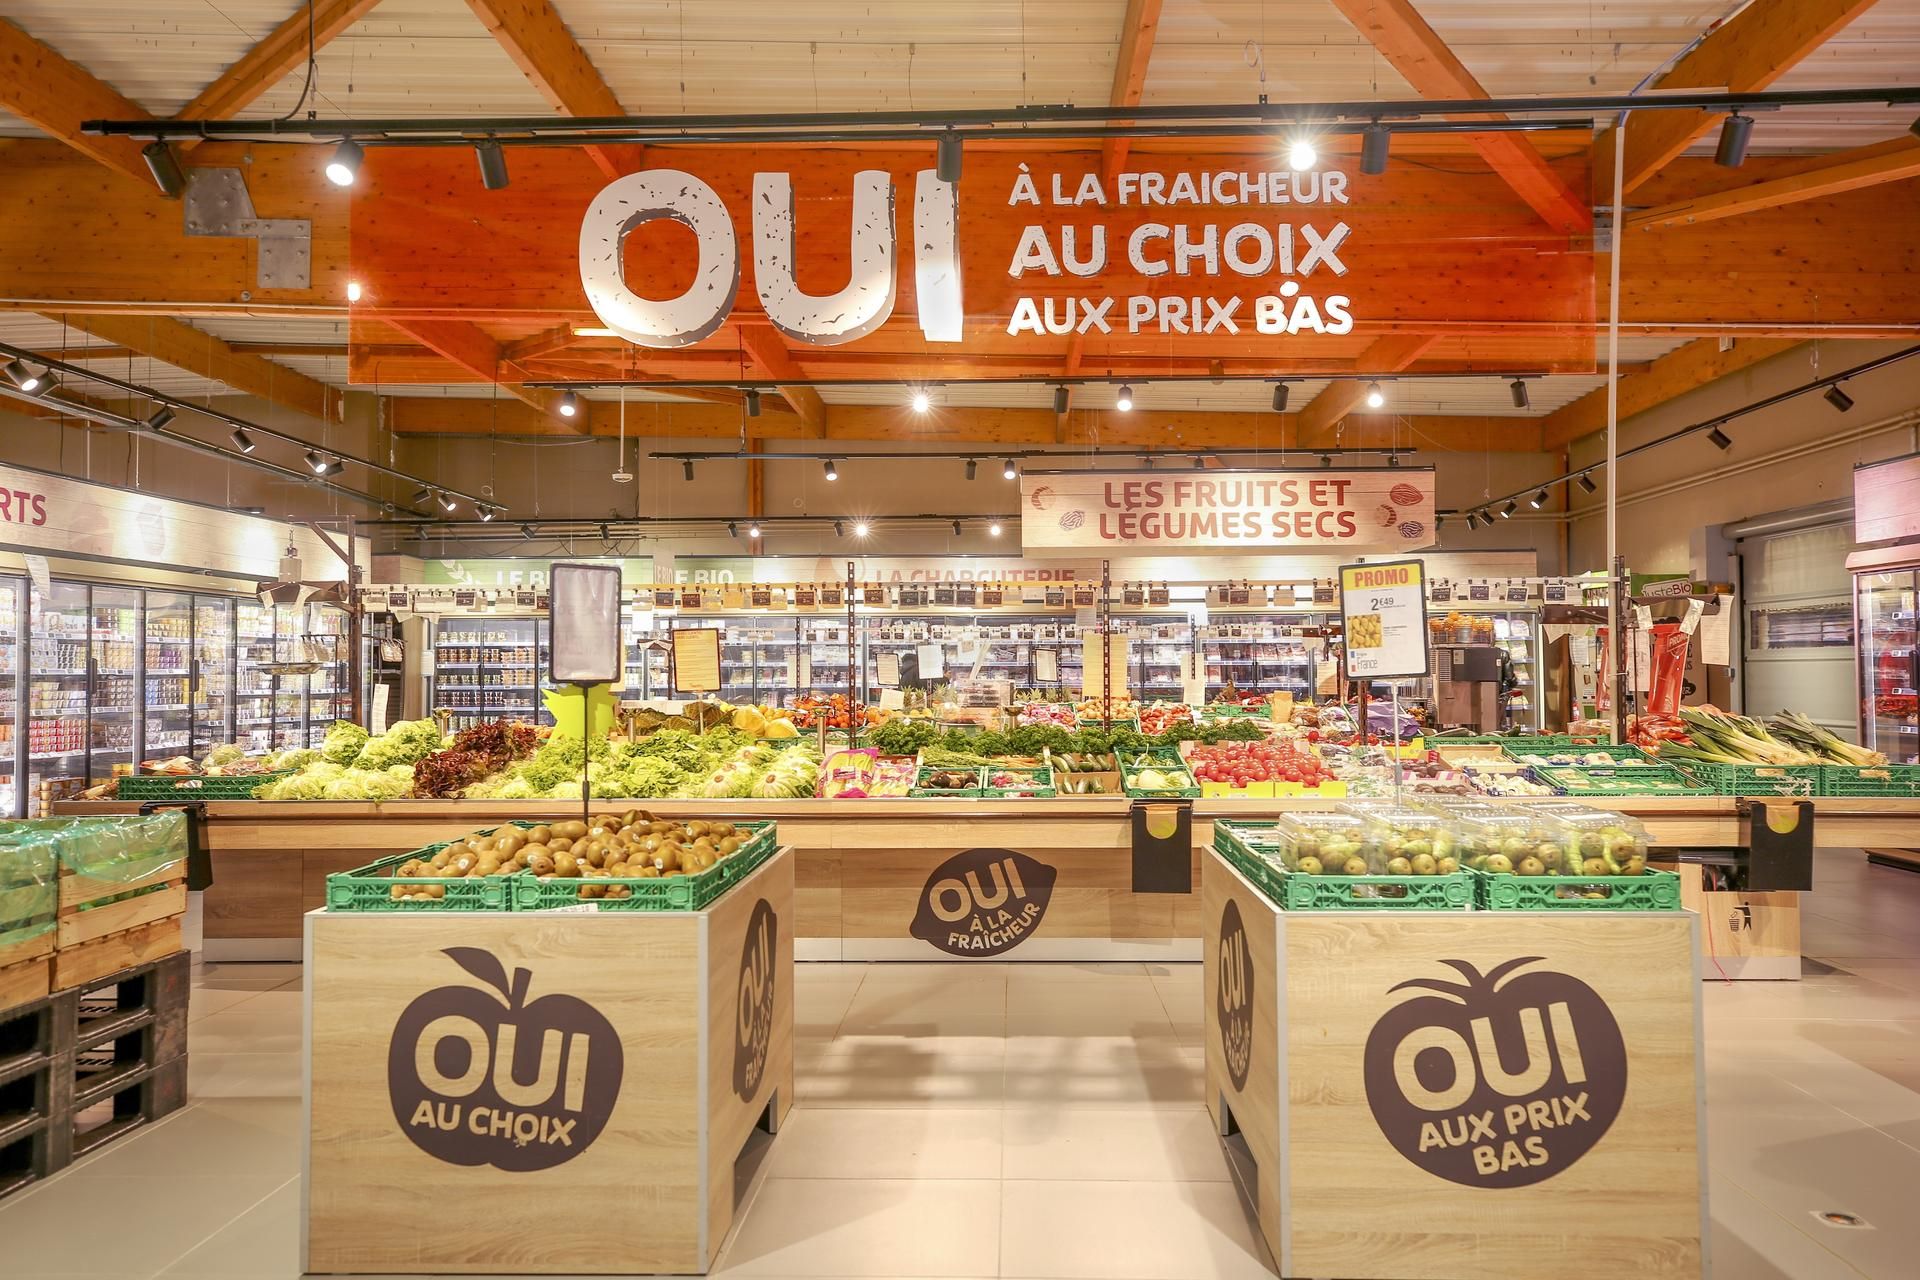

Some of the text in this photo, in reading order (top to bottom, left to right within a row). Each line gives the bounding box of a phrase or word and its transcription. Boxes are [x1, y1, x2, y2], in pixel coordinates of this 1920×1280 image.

[1008, 162, 1350, 206] À LA FRAICHEUR
[578, 168, 963, 349] OUI
[1007, 221, 1352, 280] AU CHOIX
[1006, 294, 1355, 338] AUX PRIX BAS
[1104, 479, 1352, 509] LES FRUITS ET
[1272, 510, 1357, 538] SECS
[529, 570, 550, 585] BI
[695, 569, 734, 584] BIO
[1354, 568, 1409, 588] PROMO
[1356, 658, 1378, 670] France
[929, 857, 1027, 922] OUI
[969, 909, 1013, 932] À LA
[739, 911, 770, 1047] OUI
[1221, 928, 1246, 1013] OUI
[414, 1014, 590, 1113] OUI
[1393, 1001, 1587, 1112] OUI
[410, 1099, 577, 1147] AU CHOIX
[1418, 1091, 1592, 1152] AUX PRIX
[1472, 1136, 1550, 1175] BAS
